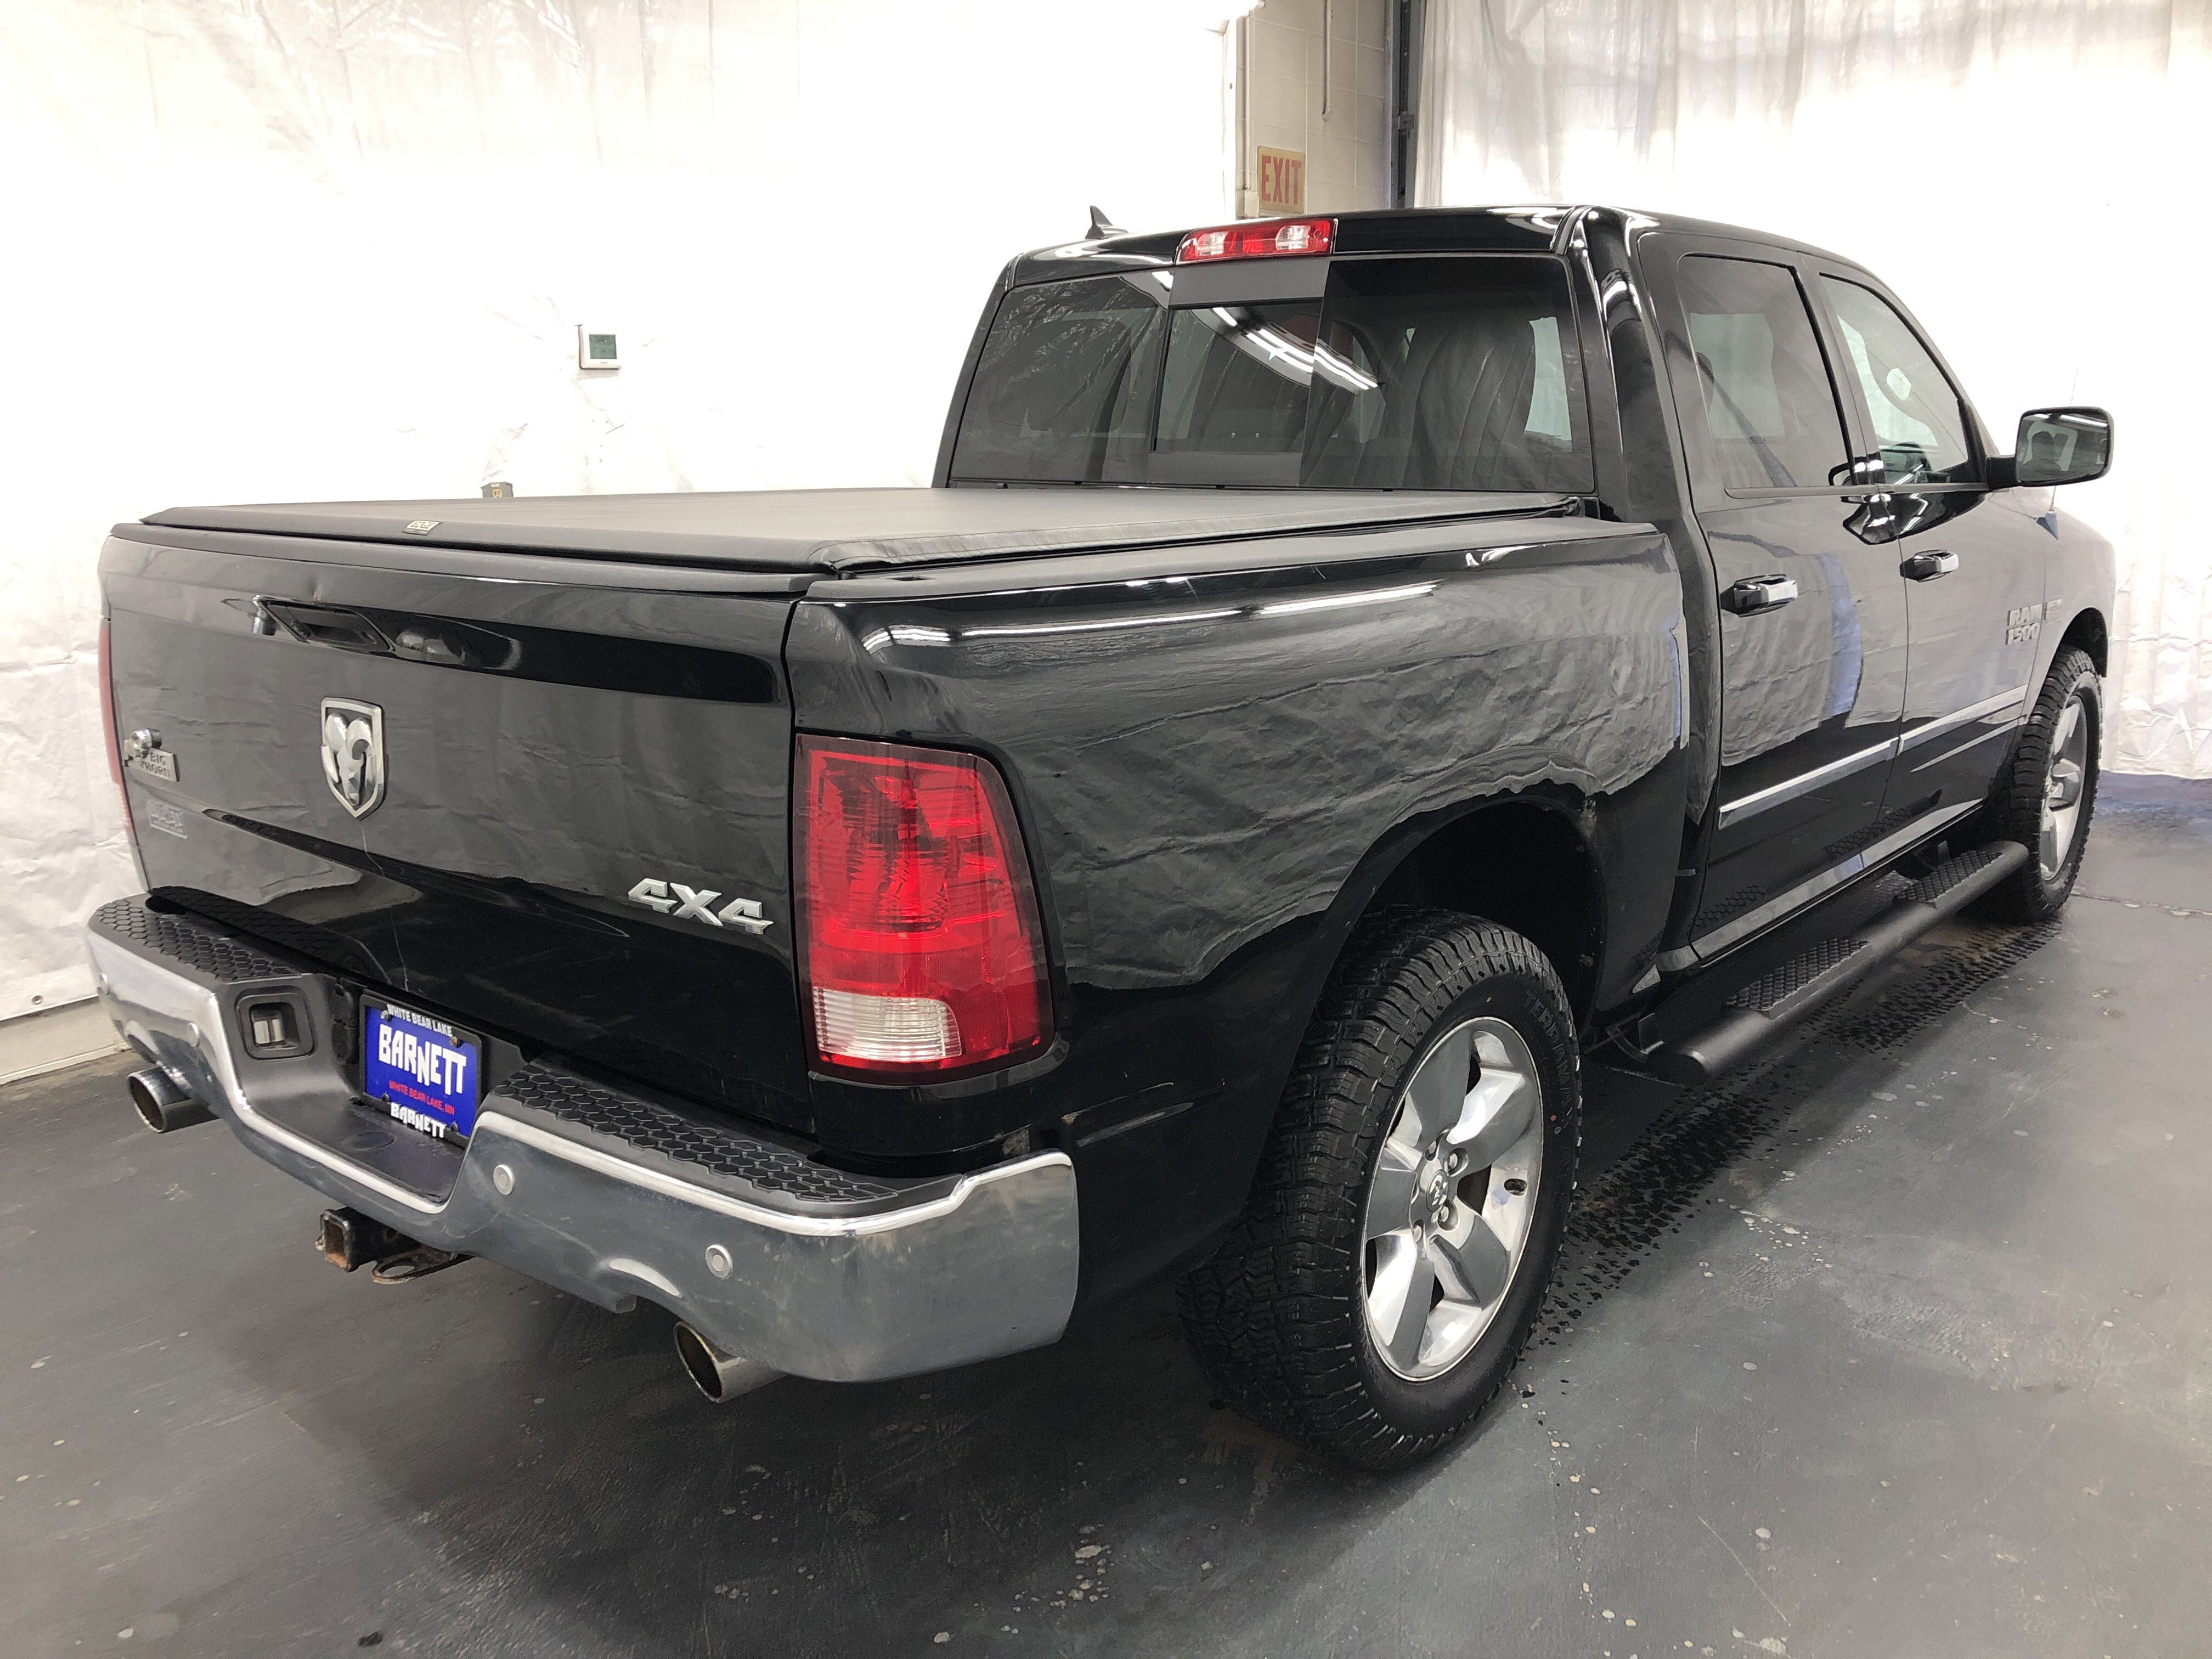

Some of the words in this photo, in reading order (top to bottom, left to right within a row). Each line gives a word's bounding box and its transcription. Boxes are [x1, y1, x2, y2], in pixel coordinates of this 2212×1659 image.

[1261, 154, 1302, 205] EXIT
[2007, 604, 2042, 627] RAM
[2005, 622, 2040, 645] 1500
[150, 752, 167, 765] BIG
[386, 1003, 411, 1022] WHITE
[411, 1012, 432, 1030] BEAR
[432, 1020, 453, 1037] LAKE
[378, 1024, 467, 1095] BARNETT
[388, 1080, 408, 1096] WHITE
[409, 1088, 426, 1103] BEAR
[391, 1102, 448, 1138] BARNETT
